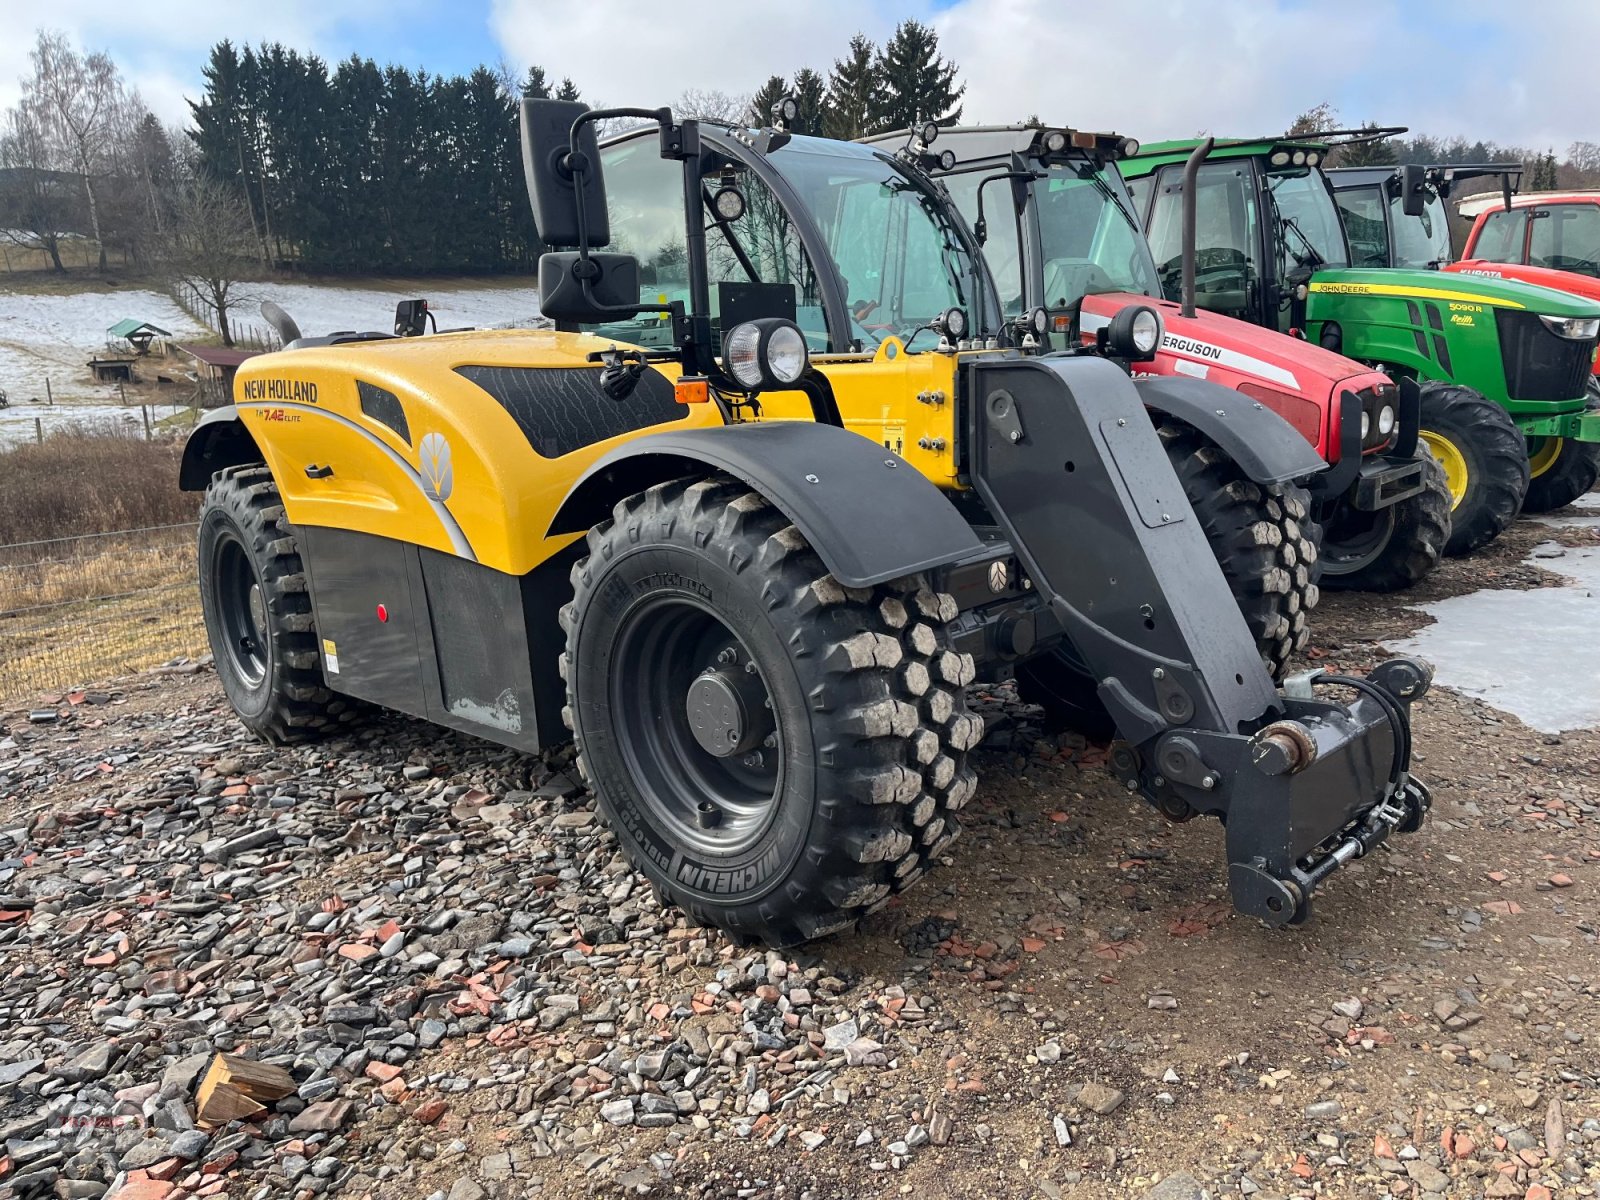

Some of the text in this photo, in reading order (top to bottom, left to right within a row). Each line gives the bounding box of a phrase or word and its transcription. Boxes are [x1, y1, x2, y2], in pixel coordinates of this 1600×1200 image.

[1318, 284, 1371, 293] JOHN DEERE
[1162, 336, 1222, 360] ERGUSON
[244, 379, 318, 404] NEW HOLLAND
[620, 809, 670, 872] BIBLOAD
[677, 843, 782, 894] MICHELIN
